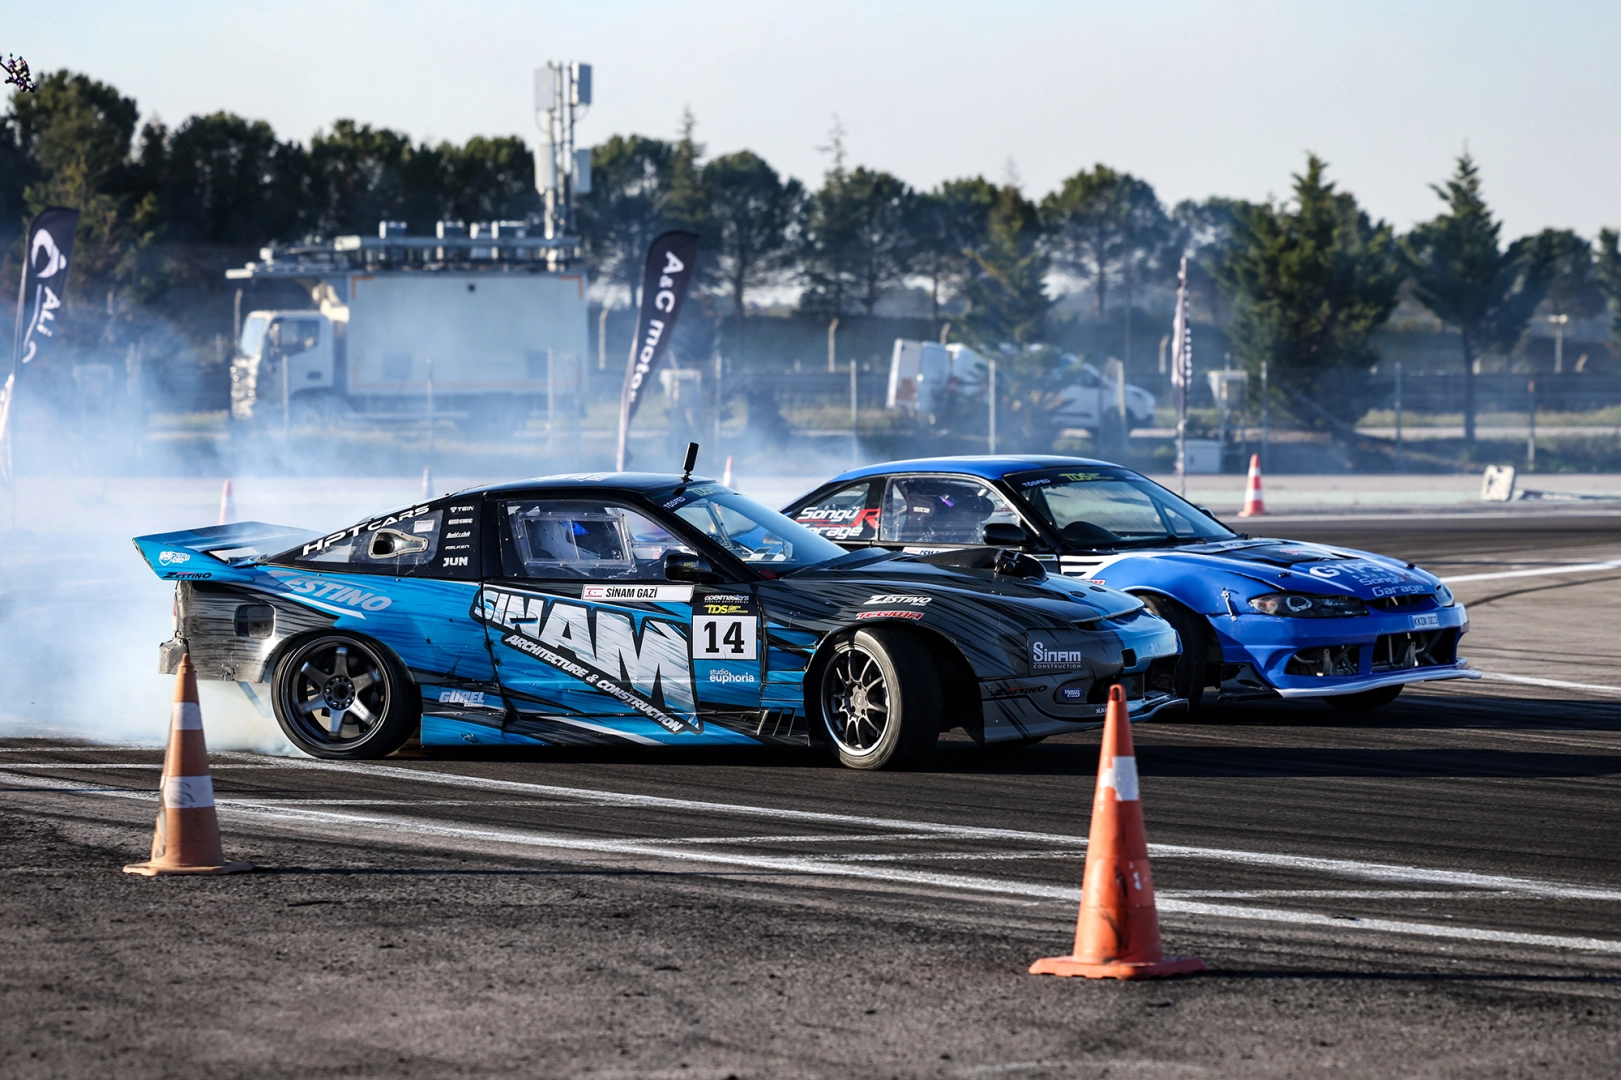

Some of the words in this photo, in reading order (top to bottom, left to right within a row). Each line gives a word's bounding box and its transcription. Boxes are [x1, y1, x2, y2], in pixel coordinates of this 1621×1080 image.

[443, 556, 469, 567] JUN
[162, 571, 213, 579] ZESTINO
[1371, 584, 1426, 597] Garage
[863, 594, 933, 606] ZESTINO
[703, 604, 728, 614] TDS
[703, 620, 745, 654] 14
[504, 634, 587, 678] ARCHITECTURE
[586, 673, 600, 684] &
[596, 679, 684, 733] CONSTRUCTION
[709, 672, 755, 685] euphoria
